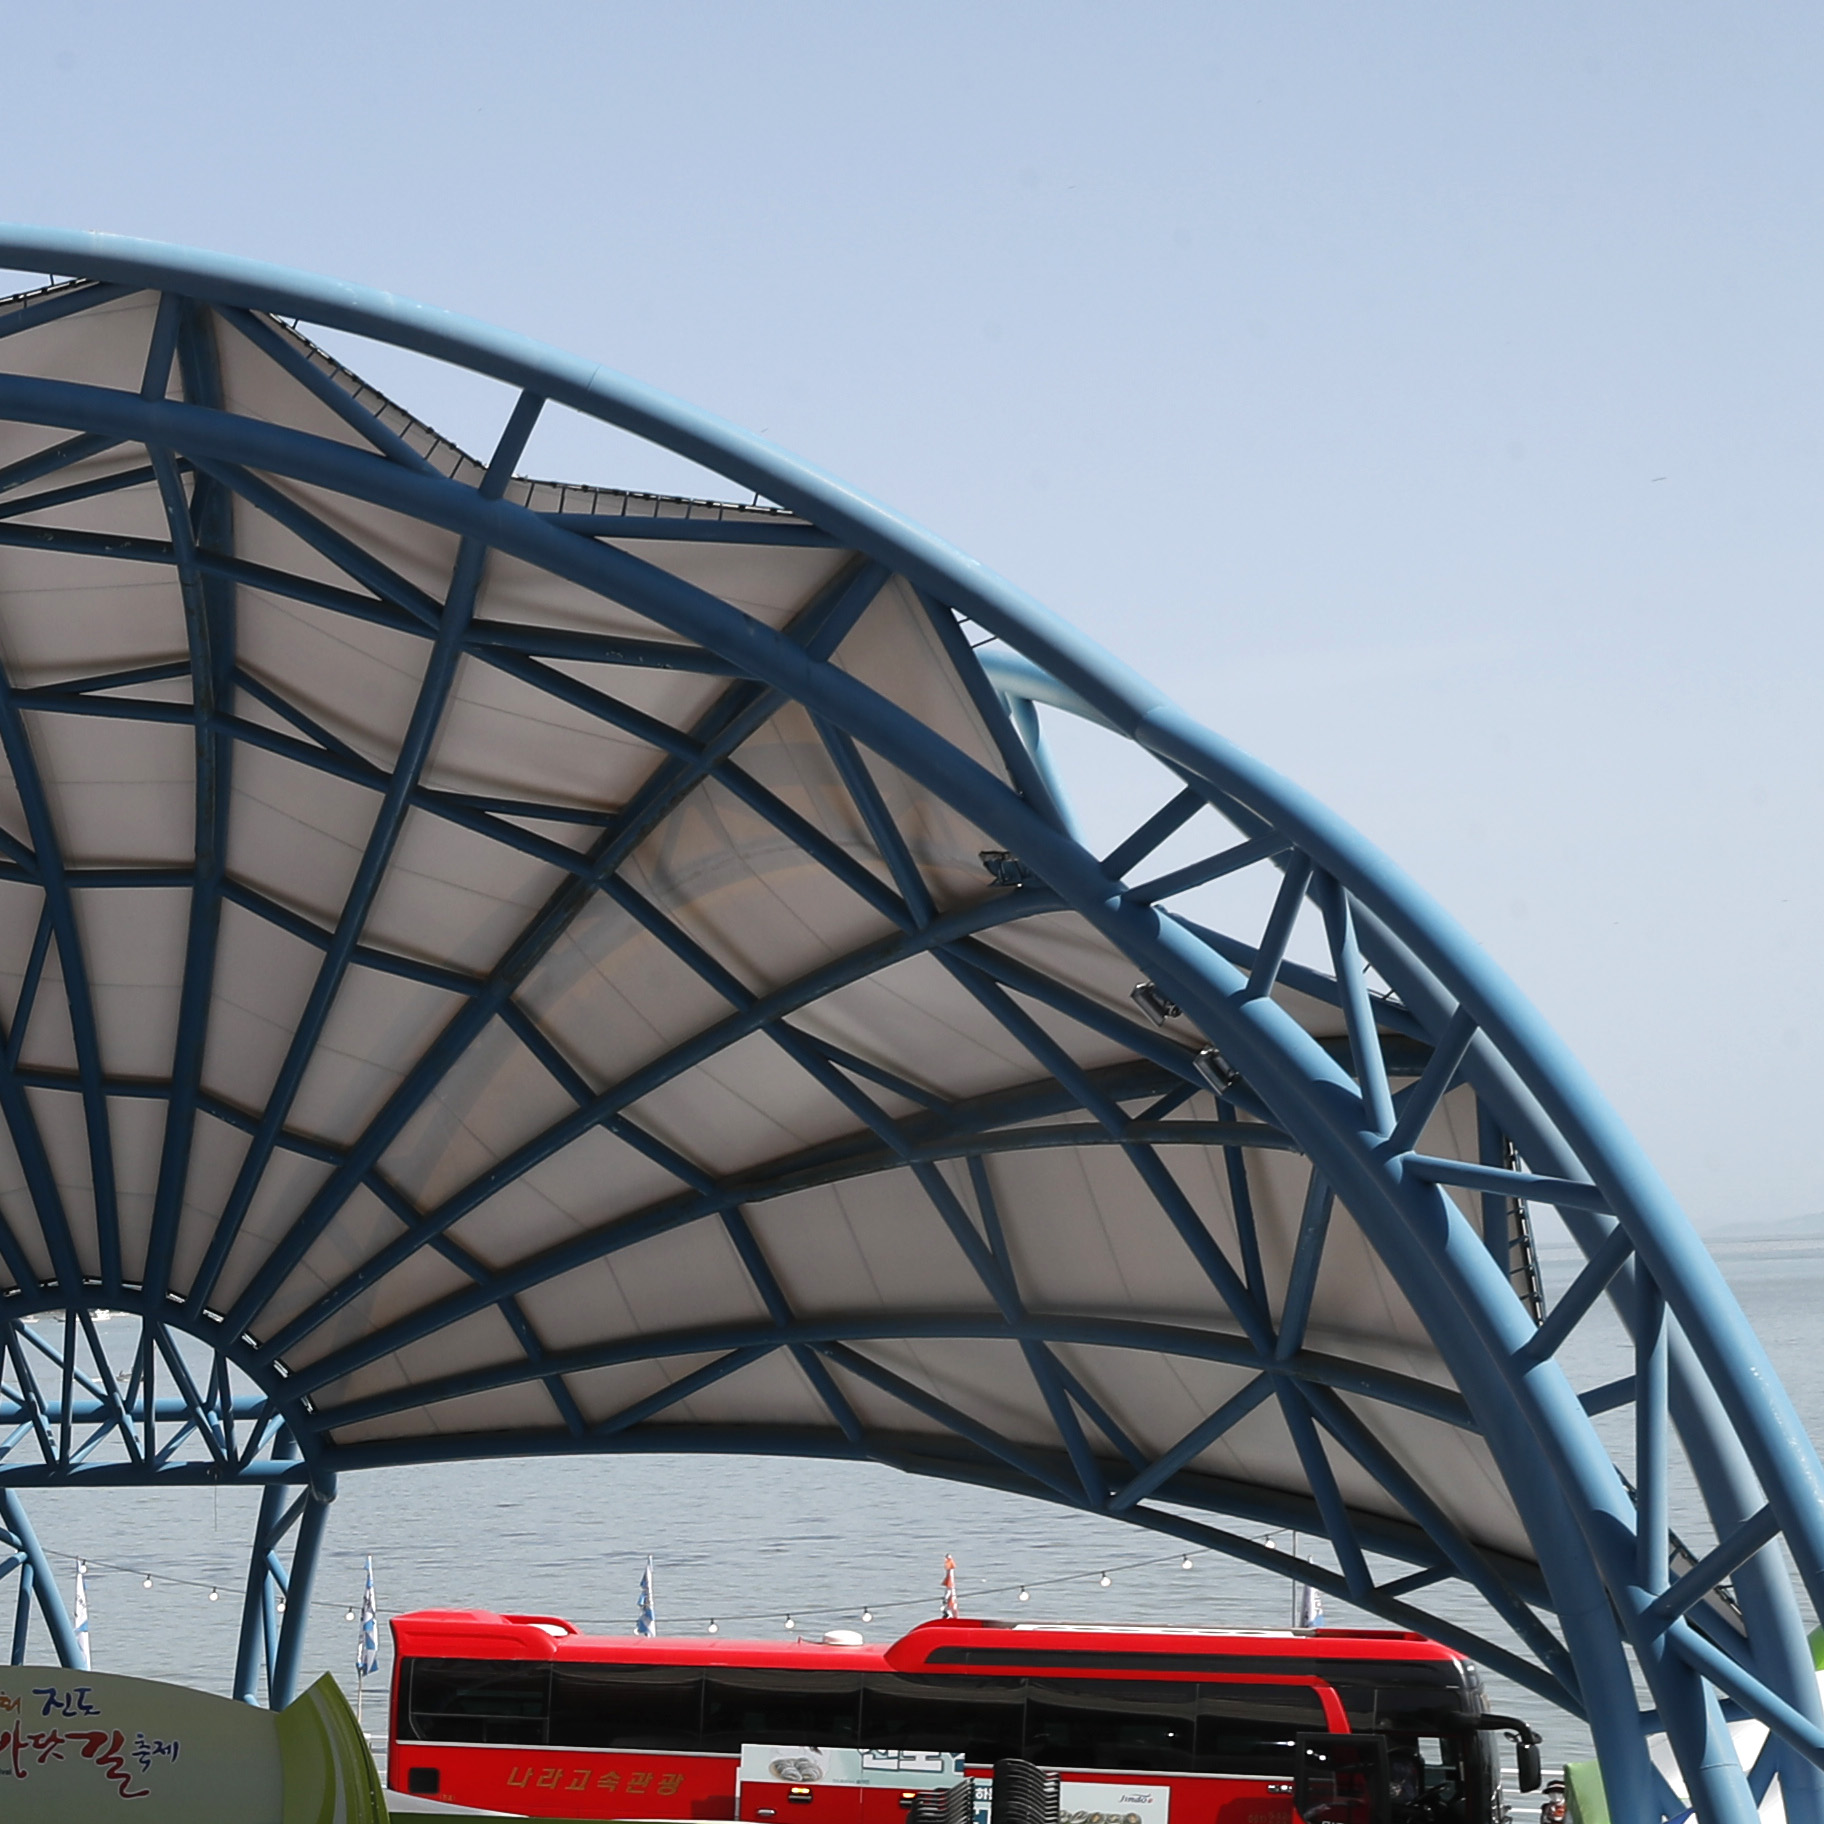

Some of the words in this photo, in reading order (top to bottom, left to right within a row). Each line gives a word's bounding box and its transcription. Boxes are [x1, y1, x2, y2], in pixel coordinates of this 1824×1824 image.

[32, 1687, 102, 1717] 진도
[132, 1732, 179, 1774] 축제
[507, 1767, 684, 1796] 나라고속관광
